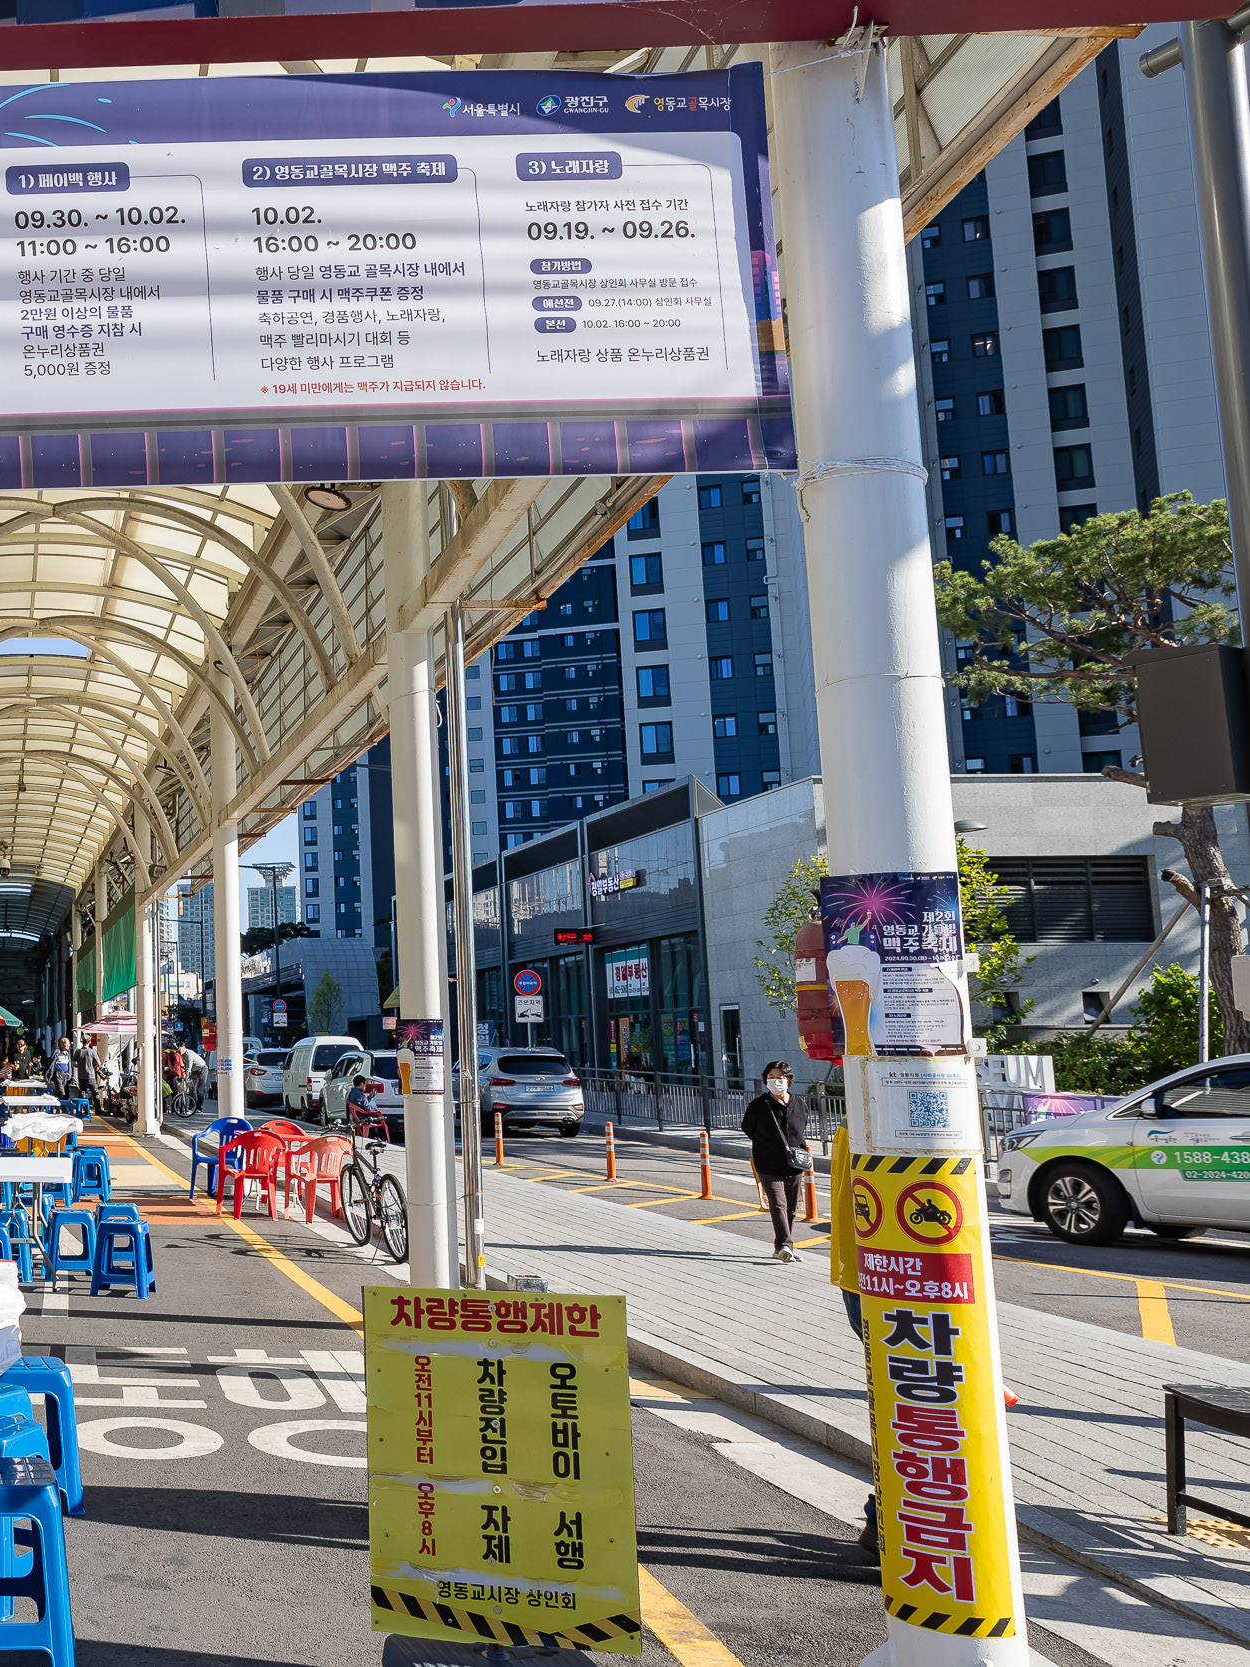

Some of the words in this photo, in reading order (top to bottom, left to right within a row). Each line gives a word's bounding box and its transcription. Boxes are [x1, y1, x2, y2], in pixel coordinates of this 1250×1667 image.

[462, 102, 520, 117] 서울특별시
[565, 95, 609, 107] 광진구
[654, 96, 731, 111] 영동교골목시장
[253, 167, 271, 181] 2)
[274, 164, 378, 180] 영동교골목시장
[382, 163, 412, 176] 맥주
[416, 162, 446, 176] 축제
[528, 161, 546, 174] 3)
[551, 160, 609, 174] 노래자랑
[18, 174, 34, 189] 1)
[39, 172, 83, 187] 페이백
[87, 171, 117, 186] 행사
[525, 201, 571, 212] 노래자랑
[575, 200, 610, 211] 참가자
[613, 200, 636, 211] 사전
[640, 200, 662, 211] 접수
[666, 199, 688, 211] 기간
[15, 209, 88, 229] 09.30.
[116, 206, 186, 225] 10.02.
[251, 206, 322, 225] 10.02.
[528, 222, 594, 241] 09.19.
[622, 220, 695, 239] 09.26.
[17, 239, 76, 257] 11:00
[105, 236, 170, 253] 16:00
[253, 235, 318, 253] 16:00
[347, 233, 416, 251] 20:00
[256, 266, 283, 281] 행사
[287, 265, 314, 280] 당일
[319, 265, 360, 280] 영동교
[364, 262, 420, 278] 골목시장
[424, 261, 465, 277] 내에서
[541, 261, 582, 271] 참가방법
[18, 269, 45, 284] 행사
[50, 269, 76, 284] 기간
[81, 268, 94, 282] 중
[99, 267, 125, 282] 당일
[533, 279, 597, 289] 영동교골목시장
[600, 278, 626, 289] 상인회
[630, 278, 657, 288] 사무실
[659, 278, 677, 288] 방문
[680, 278, 698, 288] 접수
[19, 287, 116, 304] 영동교골목시장
[120, 285, 160, 300] 내에서
[257, 290, 284, 304] 물품
[288, 289, 315, 303] 구매
[320, 289, 333, 302] 시
[337, 287, 393, 302] 맥주쿠폰
[397, 286, 424, 301] 증정
[589, 297, 652, 307] 09.27.(14:00)
[655, 297, 682, 306] 상인회
[685, 297, 712, 306] 사무실
[21, 308, 57, 321] 2만원
[62, 306, 101, 319] 이상의
[106, 306, 133, 319] 물품
[258, 311, 317, 326] 축하공연,
[322, 310, 381, 325] 경품행사,
[386, 308, 445, 323] 노래자랑,
[22, 324, 48, 340] 구매
[52, 324, 93, 339] 영수증
[98, 323, 125, 337] 지참
[129, 322, 142, 336] 시
[545, 319, 566, 330] 본선
[582, 320, 611, 329] 10.02.
[614, 319, 640, 328] 16:00
[653, 319, 681, 328] 20:00
[259, 333, 287, 349] 맥주
[291, 332, 360, 348] 빨리마시기
[366, 331, 392, 346] 대회
[397, 331, 410, 345] 등
[23, 342, 104, 358] 온누리상품권
[537, 348, 591, 363] 노래자랑
[596, 348, 623, 362] 상품
[628, 347, 710, 362] 온누리상품권
[24, 363, 79, 379] 5,000원
[84, 362, 110, 376] 증정
[261, 356, 302, 371] 다양한
[306, 355, 334, 370] 행사
[339, 354, 393, 369] 프로그램
[272, 383, 297, 394] 19세
[301, 381, 354, 393] 미만에게는
[357, 381, 389, 392] 맥주가
[393, 379, 436, 392] 지급되지
[439, 378, 486, 391] 않습니다.
[922, 911, 955, 922] 제2회
[883, 924, 920, 935] 영동교
[864, 1253, 922, 1275] 제한시간
[390, 1295, 601, 1338] 차량통행제한
[477, 1358, 508, 1475] 차량진입
[549, 1362, 581, 1480] 오토바이
[881, 1307, 975, 1603] 차량통행금지
[417, 1483, 436, 1556] 오후8시
[480, 1504, 511, 1563] 자제
[553, 1511, 584, 1570] 서행
[438, 1581, 520, 1604] 영동교시장
[526, 1589, 576, 1611] 상인회
